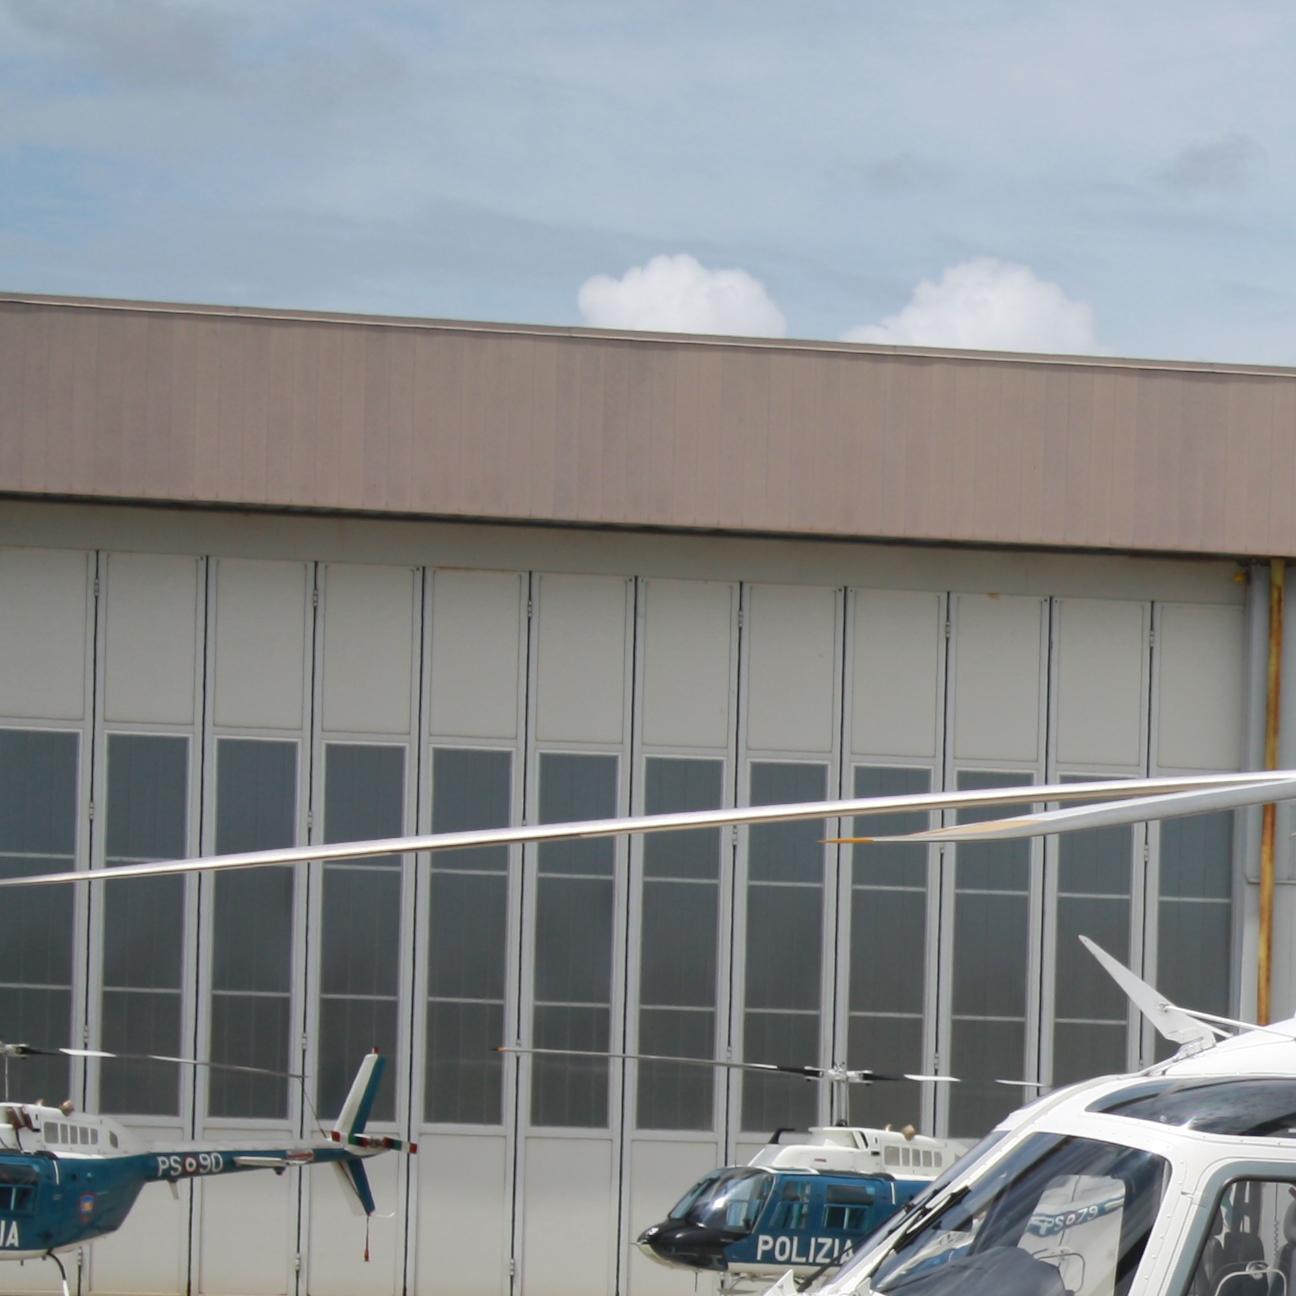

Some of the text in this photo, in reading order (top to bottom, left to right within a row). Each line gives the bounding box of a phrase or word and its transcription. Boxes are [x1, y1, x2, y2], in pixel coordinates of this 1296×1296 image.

[156, 1155, 182, 1177] PS
[1039, 1205, 1099, 1235] PS 79
[757, 1234, 855, 1264] POLIZIA
